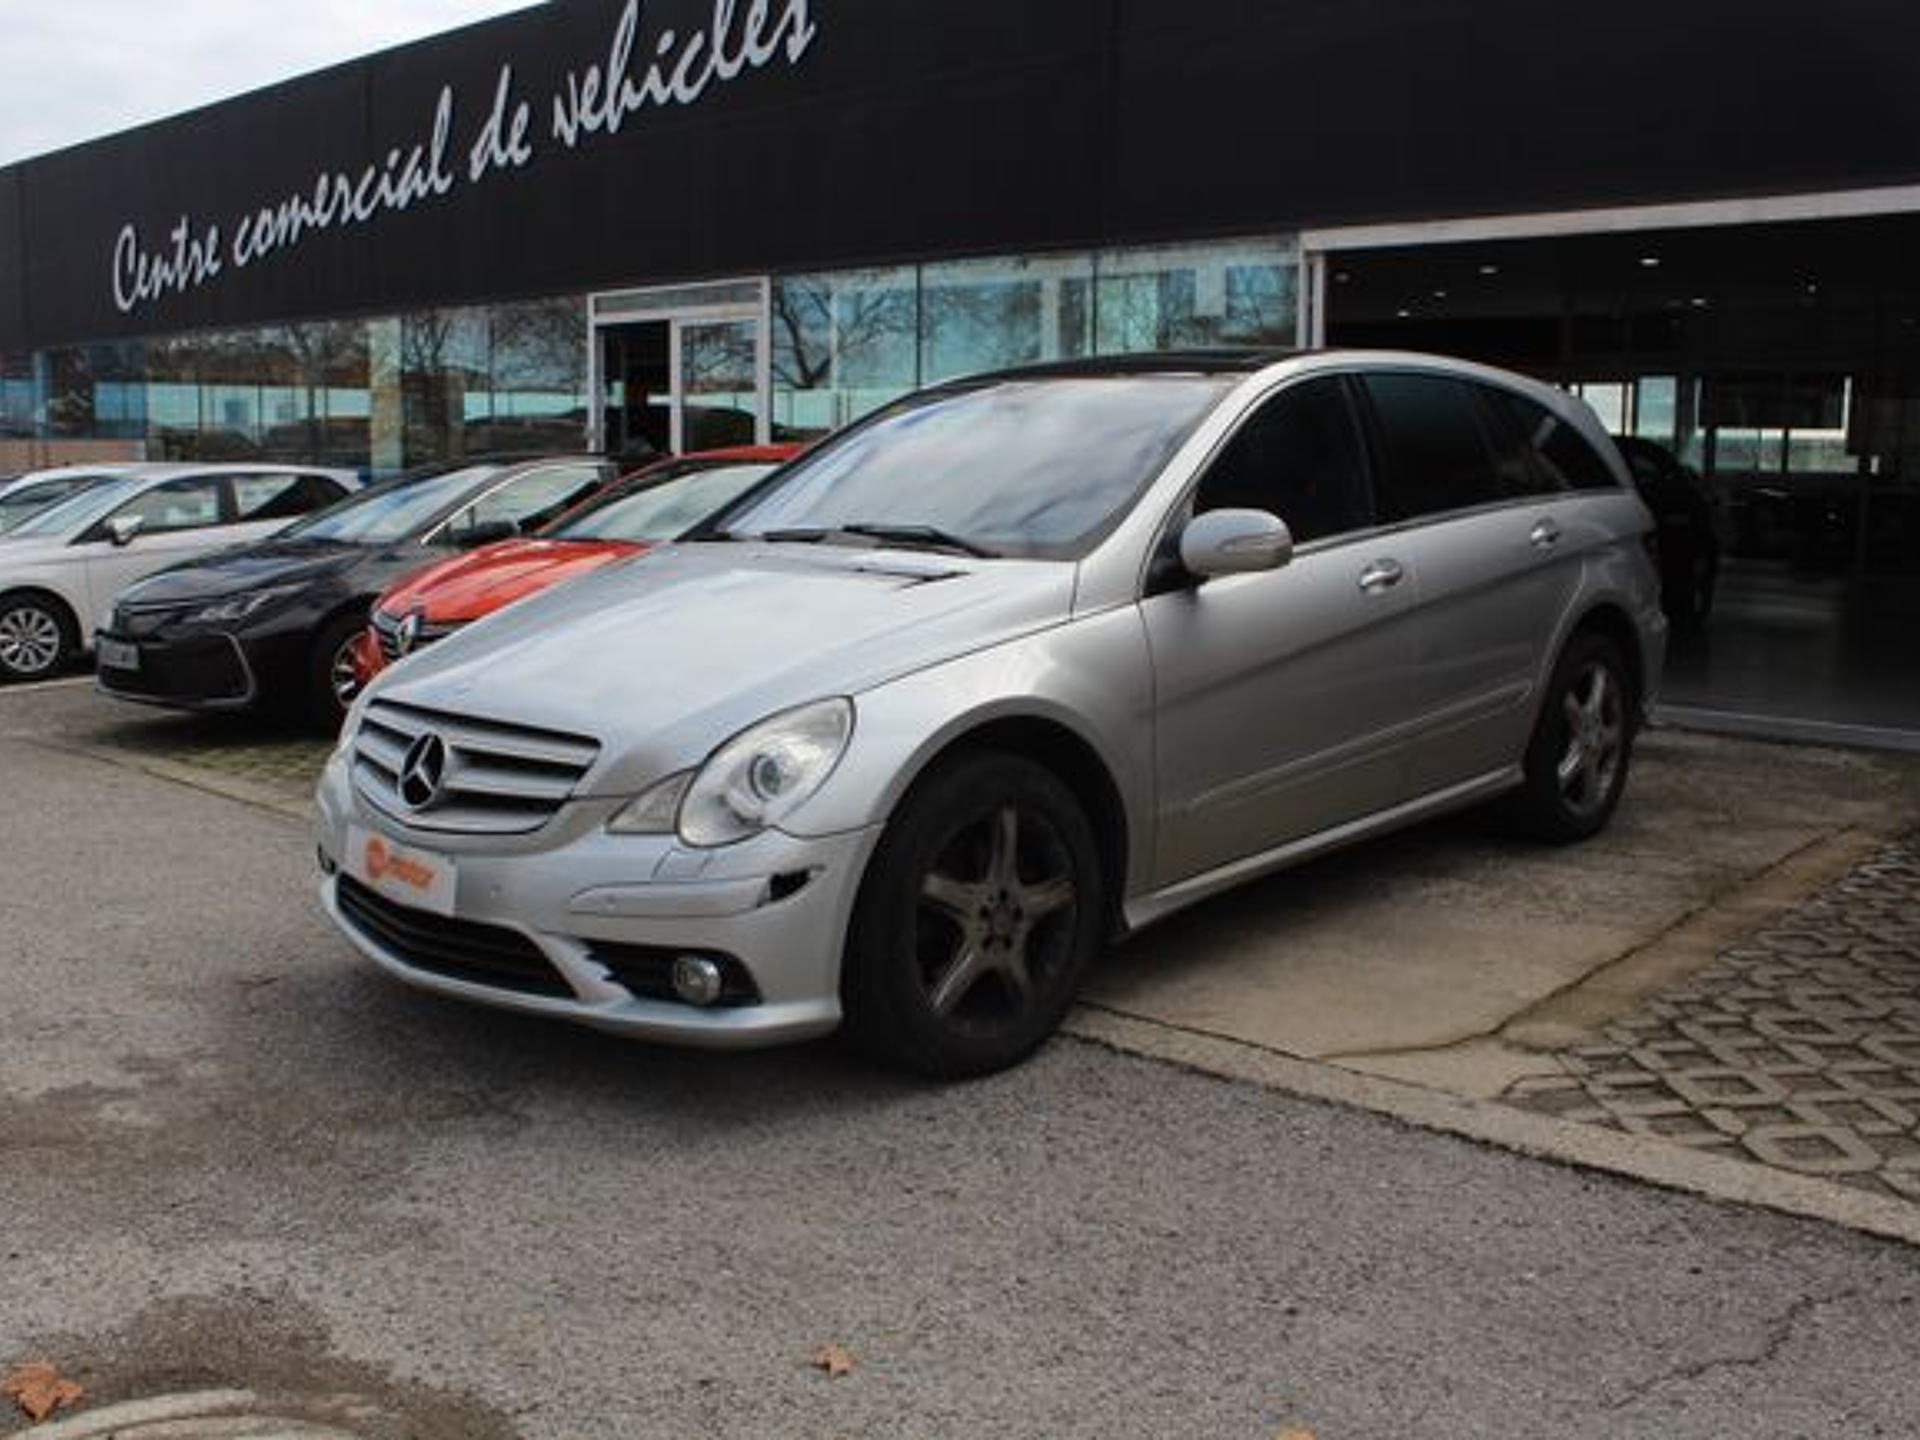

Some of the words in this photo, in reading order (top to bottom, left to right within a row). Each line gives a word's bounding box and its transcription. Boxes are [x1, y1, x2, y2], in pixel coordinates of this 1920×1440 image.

[114, 217, 221, 310] Centre
[234, 86, 453, 266] comercial
[470, 65, 531, 181] de
[554, 0, 815, 147] vehicles
